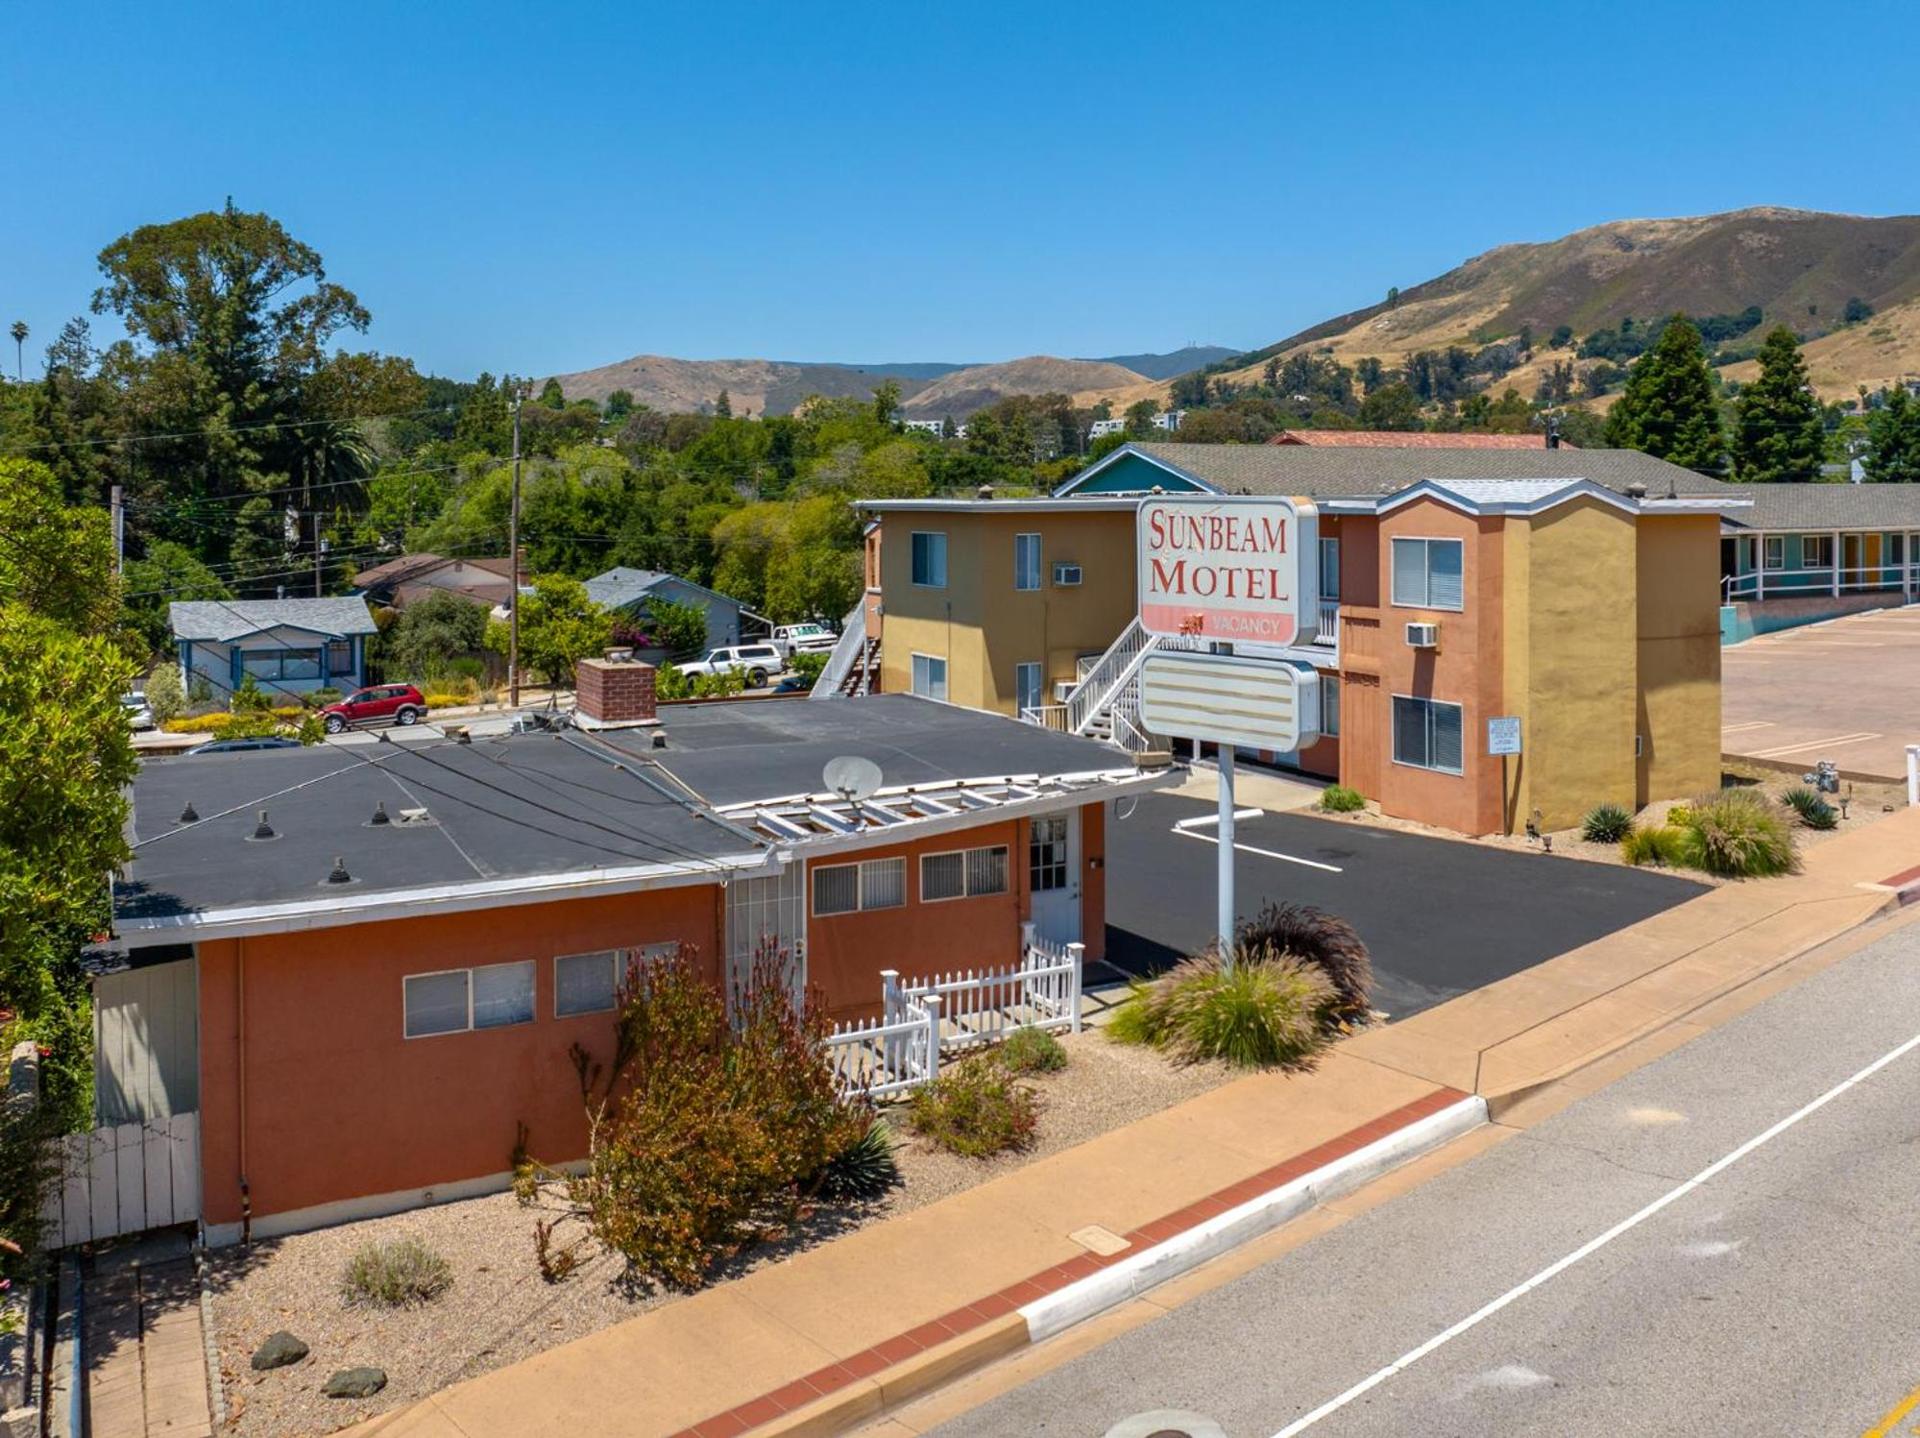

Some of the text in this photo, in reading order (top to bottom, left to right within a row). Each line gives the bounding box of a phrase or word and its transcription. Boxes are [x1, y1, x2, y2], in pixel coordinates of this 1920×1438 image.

[1150, 509, 1287, 554] SUNBEAM
[1150, 558, 1289, 601] MOTEL
[1211, 615, 1281, 634] VACANCY
